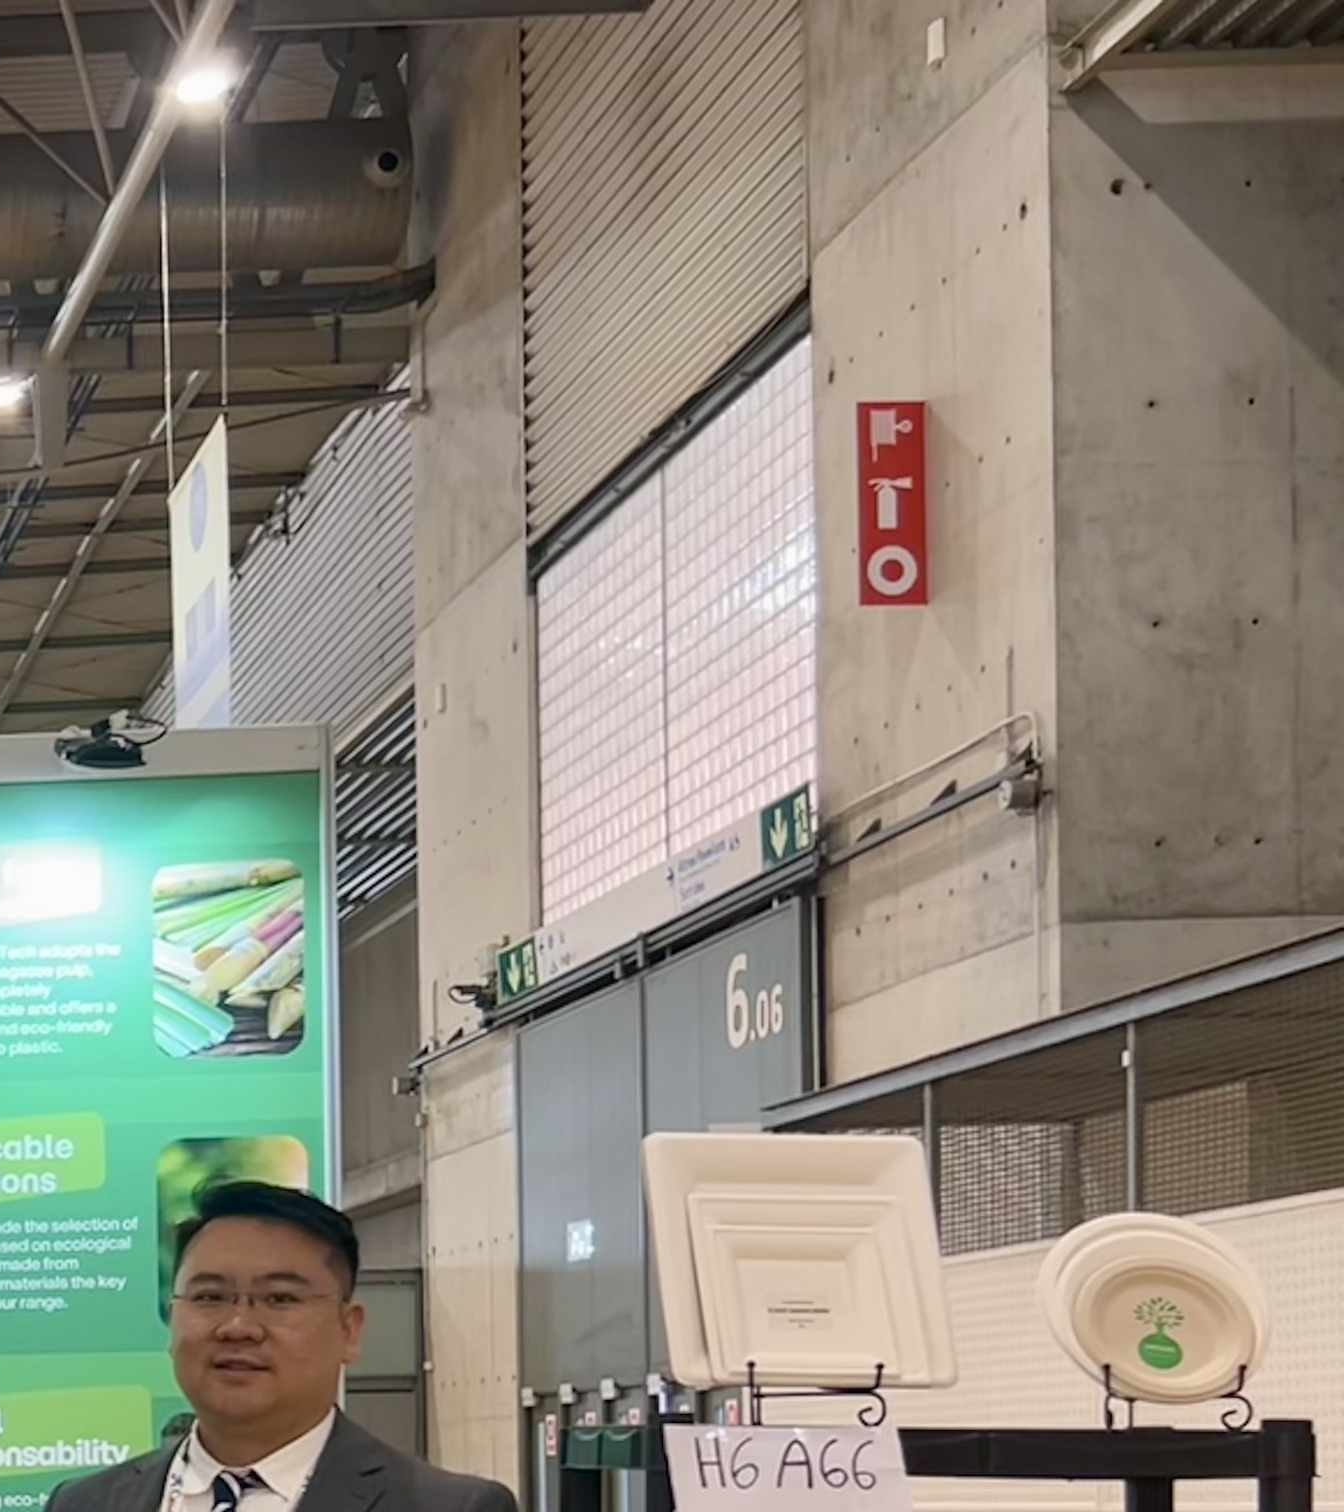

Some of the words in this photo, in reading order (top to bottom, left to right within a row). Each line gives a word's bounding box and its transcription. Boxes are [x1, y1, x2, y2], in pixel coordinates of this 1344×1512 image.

[38, 943, 92, 962] adopts
[95, 942, 122, 957] the
[55, 964, 94, 980] pulp,
[27, 1002, 56, 1017] and
[58, 1000, 105, 1016] offers
[106, 1003, 118, 1014] a
[725, 951, 784, 1050] 6.06
[20, 1020, 113, 1037] eco-friendly
[8, 1040, 64, 1058] plastic.
[23, 1219, 49, 1233] the
[51, 1216, 121, 1233] selection
[122, 1216, 140, 1231] of
[31, 1239, 52, 1252] on
[53, 1235, 133, 1254] ecological
[42, 1256, 80, 1271] from
[70, 1275, 96, 1289] the
[97, 1274, 128, 1291] key
[18, 1296, 69, 1313] range.
[693, 1436, 760, 1490] H6
[776, 1437, 878, 1491] A66
